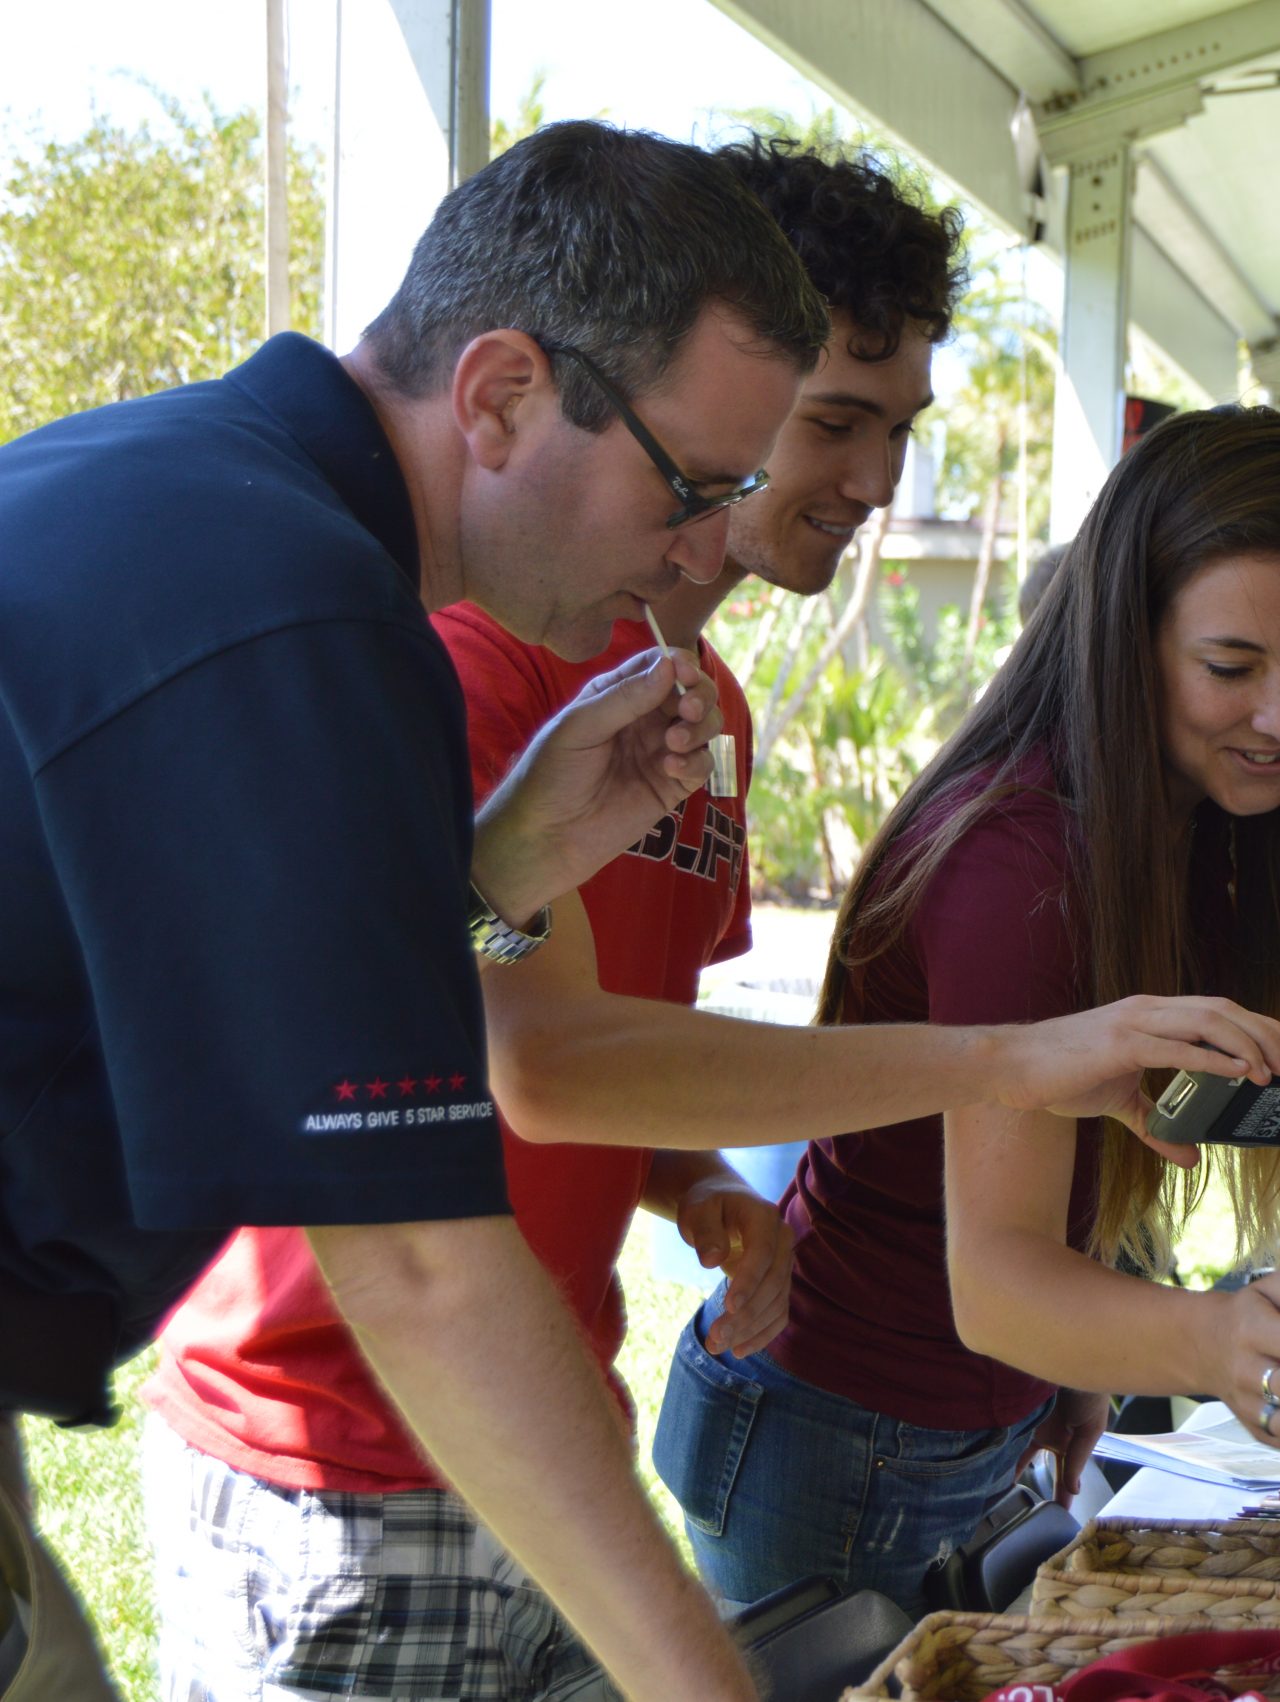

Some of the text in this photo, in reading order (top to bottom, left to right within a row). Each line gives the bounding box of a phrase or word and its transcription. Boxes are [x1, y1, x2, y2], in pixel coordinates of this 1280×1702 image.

[306, 1102, 493, 1130] ALWAYS GIVE 5 STAR SERVICE
